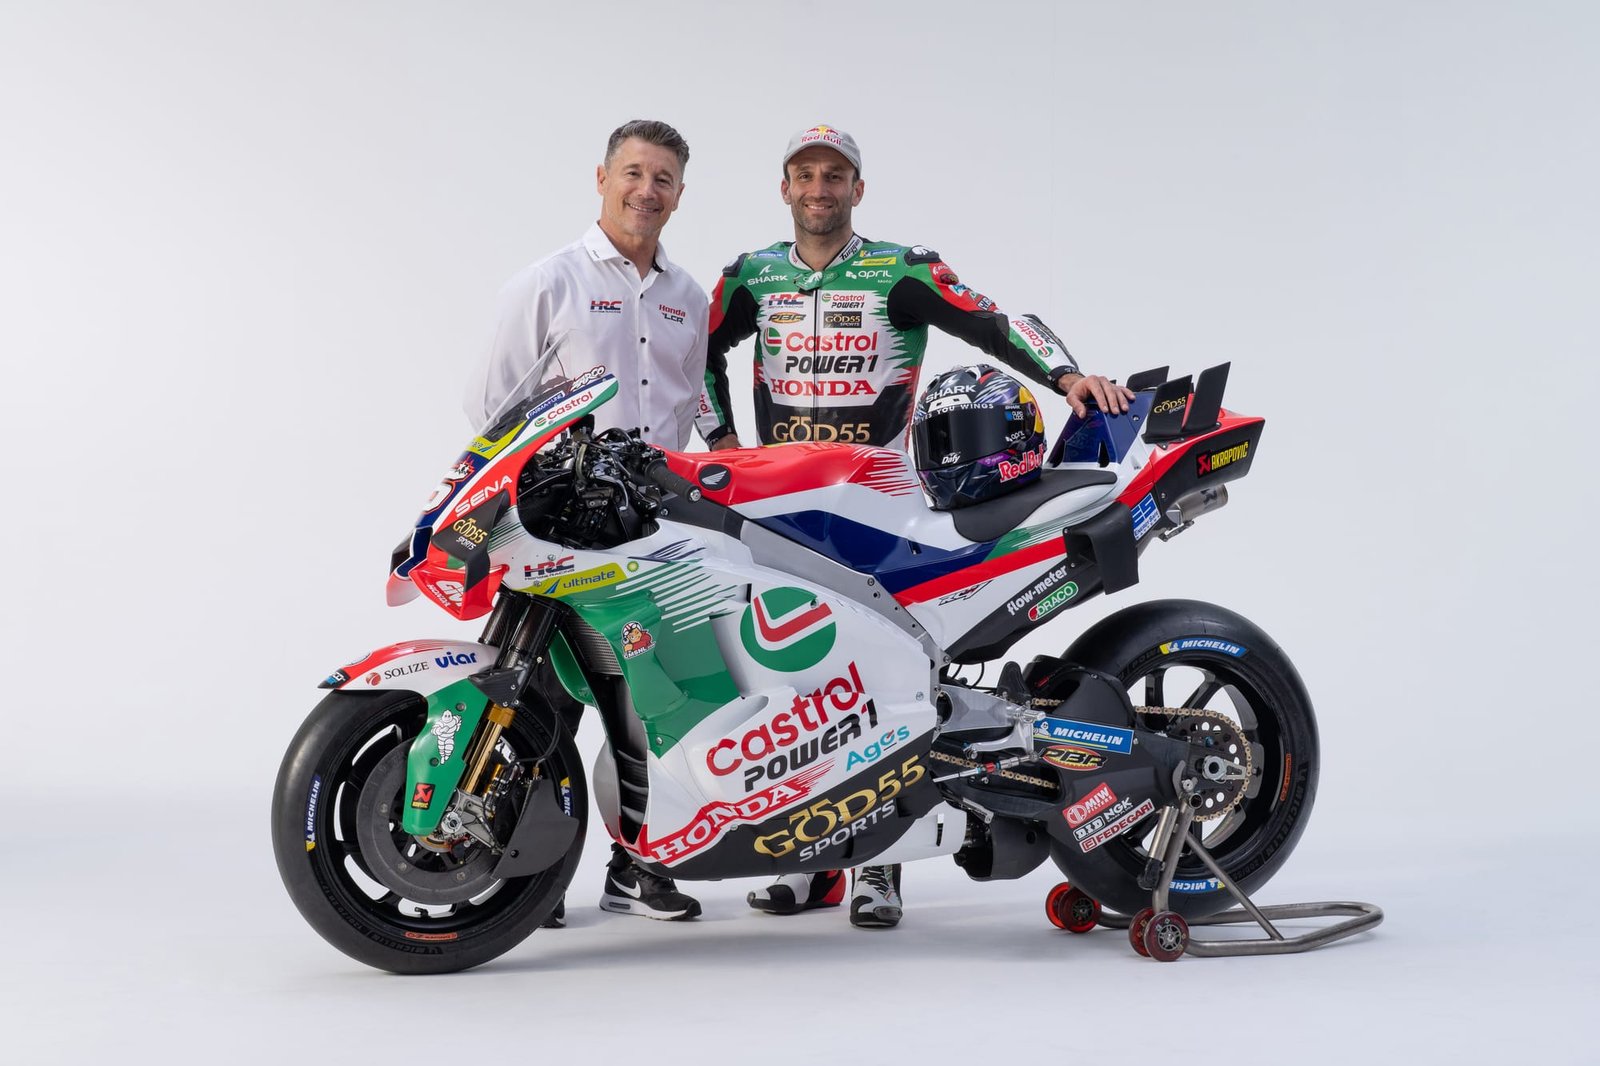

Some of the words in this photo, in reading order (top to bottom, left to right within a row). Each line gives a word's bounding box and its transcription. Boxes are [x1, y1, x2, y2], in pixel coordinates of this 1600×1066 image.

[801, 134, 820, 143] Red
[823, 134, 842, 146] Bull
[747, 275, 788, 285] SHARK
[858, 270, 892, 279] april
[590, 300, 622, 310] HRC
[769, 293, 805, 306] HRC
[659, 304, 686, 317] Honda
[662, 313, 684, 325] LCR
[785, 331, 877, 351] Castrol
[1011, 319, 1045, 347] Castrol
[785, 356, 878, 374] POWER1
[771, 379, 877, 396] HONDA
[926, 385, 976, 403] SHARK
[548, 391, 593, 420] Castrol
[937, 406, 955, 414] YOU
[942, 454, 960, 464] Dafy
[998, 452, 1028, 483] Red
[455, 475, 512, 517] SENA
[524, 555, 574, 577] HRC
[563, 570, 615, 588] ultimate
[1007, 565, 1068, 616] flow-meter
[1037, 585, 1074, 616] DRACO
[1181, 640, 1240, 654] MICHELIN
[384, 661, 429, 679] SOLIZE
[706, 660, 865, 777] Castrol
[744, 699, 878, 793] POWER1
[1053, 727, 1124, 746] MICHELIN
[1038, 747, 1108, 767] PBR
[307, 780, 320, 831] MICHELIN
[1084, 787, 1110, 811] MIW
[1103, 797, 1132, 820] NGK
[651, 780, 803, 860] HONDA
[1096, 802, 1153, 843] FEDEGARI
[799, 800, 895, 863] SPORTS
[1169, 881, 1206, 891] MICHE
